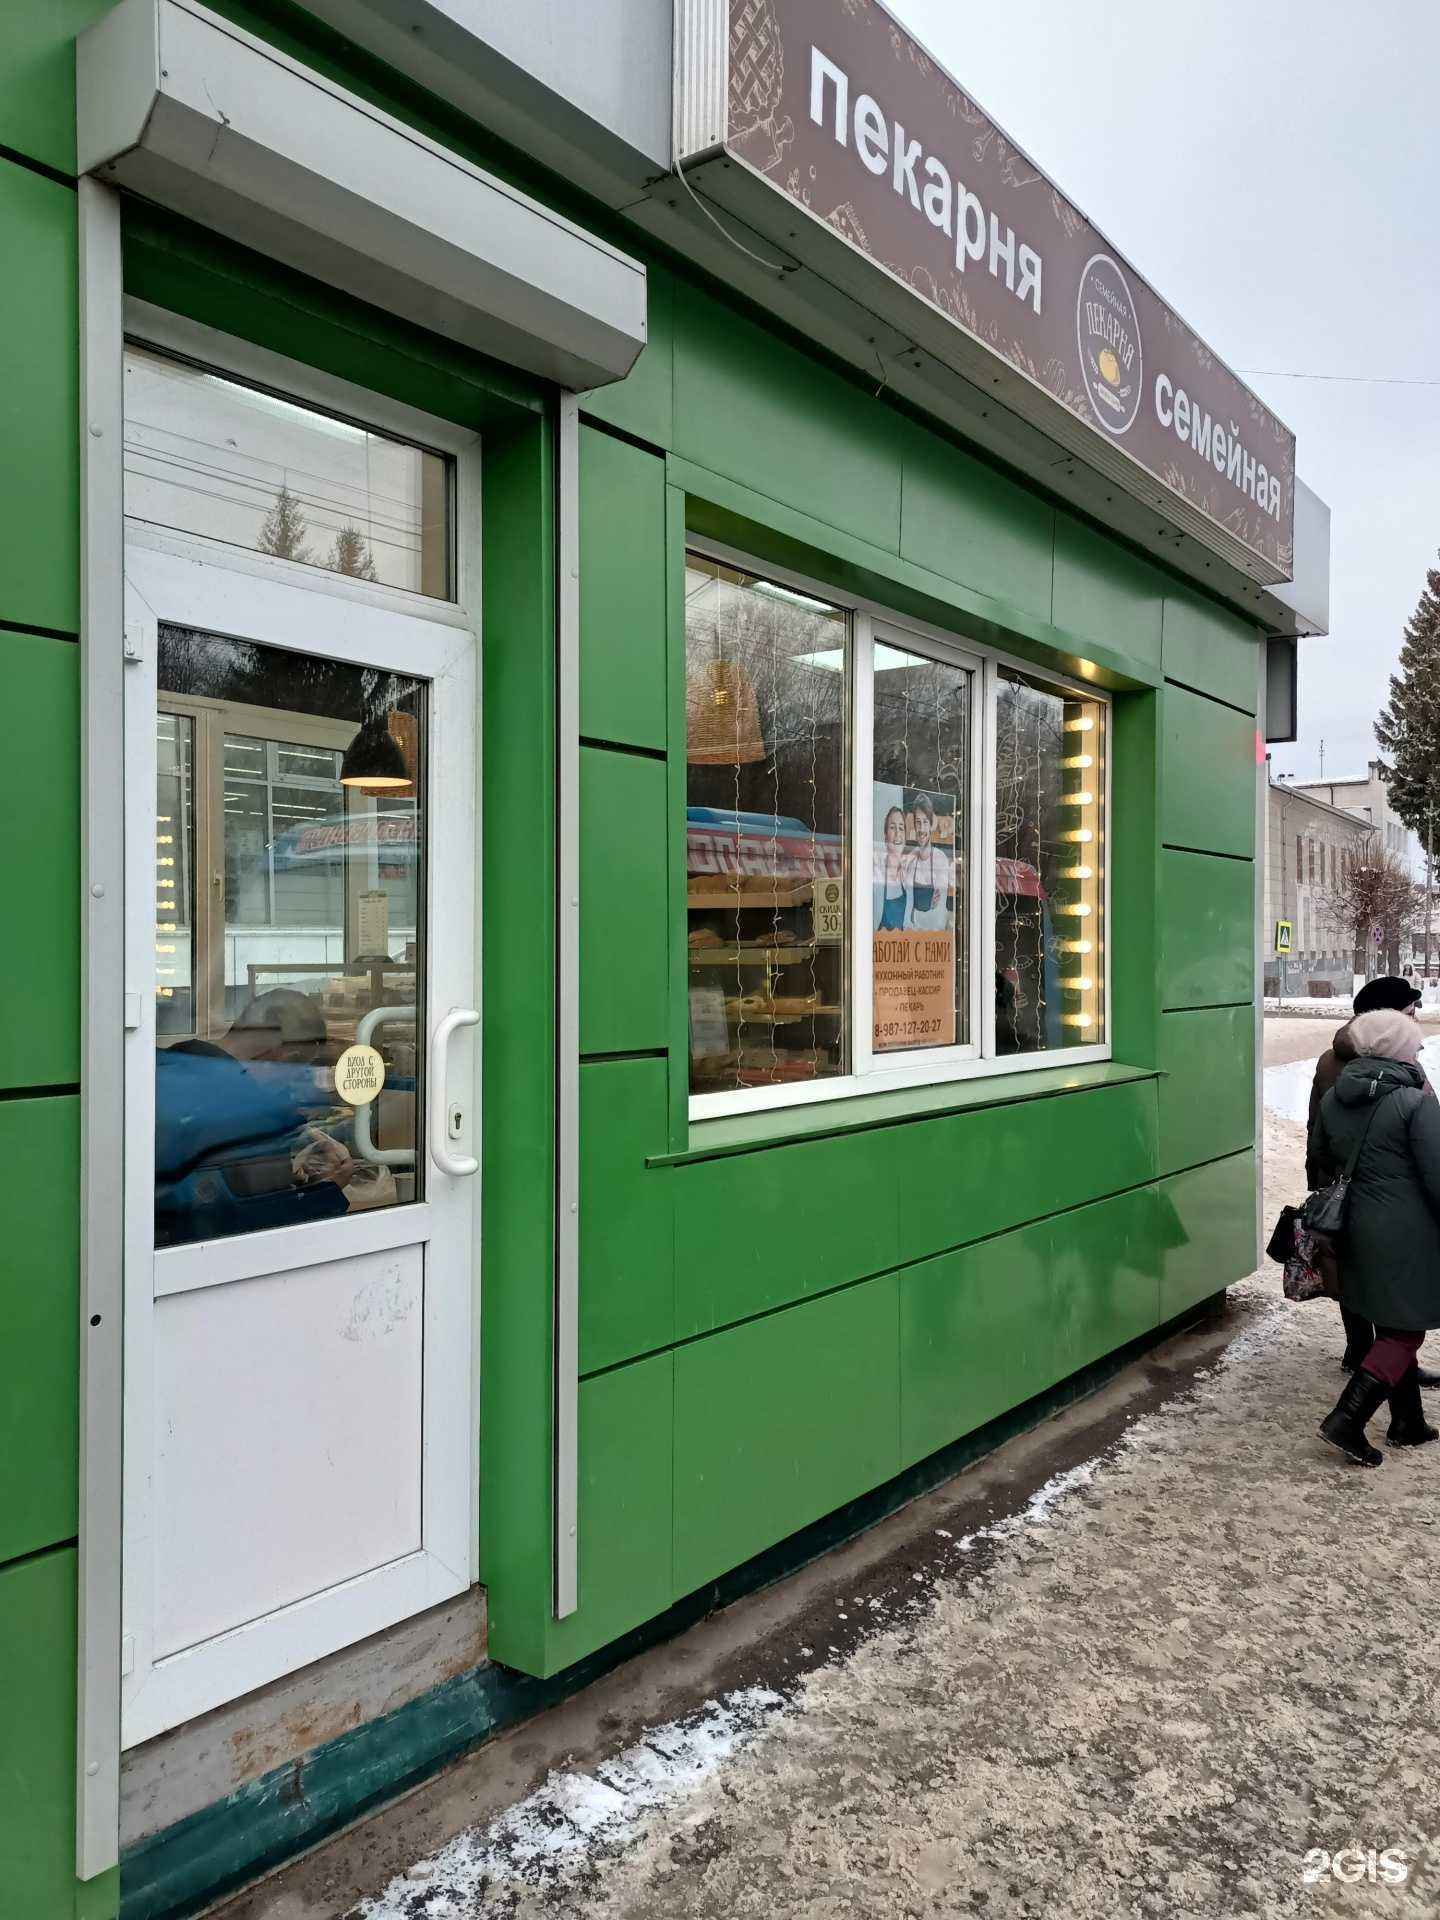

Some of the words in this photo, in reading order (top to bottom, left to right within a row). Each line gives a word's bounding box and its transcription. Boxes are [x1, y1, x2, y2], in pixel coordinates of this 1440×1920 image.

[810, 45, 1042, 316] пекарня
[1094, 277, 1127, 317] СЕМЕЙНАЯ
[1085, 301, 1135, 371] ПЕКАРНЯ
[1155, 373, 1281, 522] семейная
[914, 941, 921, 963] С
[925, 941, 951, 963] НАМИ
[914, 969, 945, 980] РАБОТНИК
[874, 1019, 943, 1037] 8-987-127-20-27
[347, 1056, 365, 1067] ВХОД
[368, 1056, 375, 1066] С
[345, 1066, 375, 1079] ДРУГОЙ
[343, 1077, 377, 1090] СТОРОНЫ
